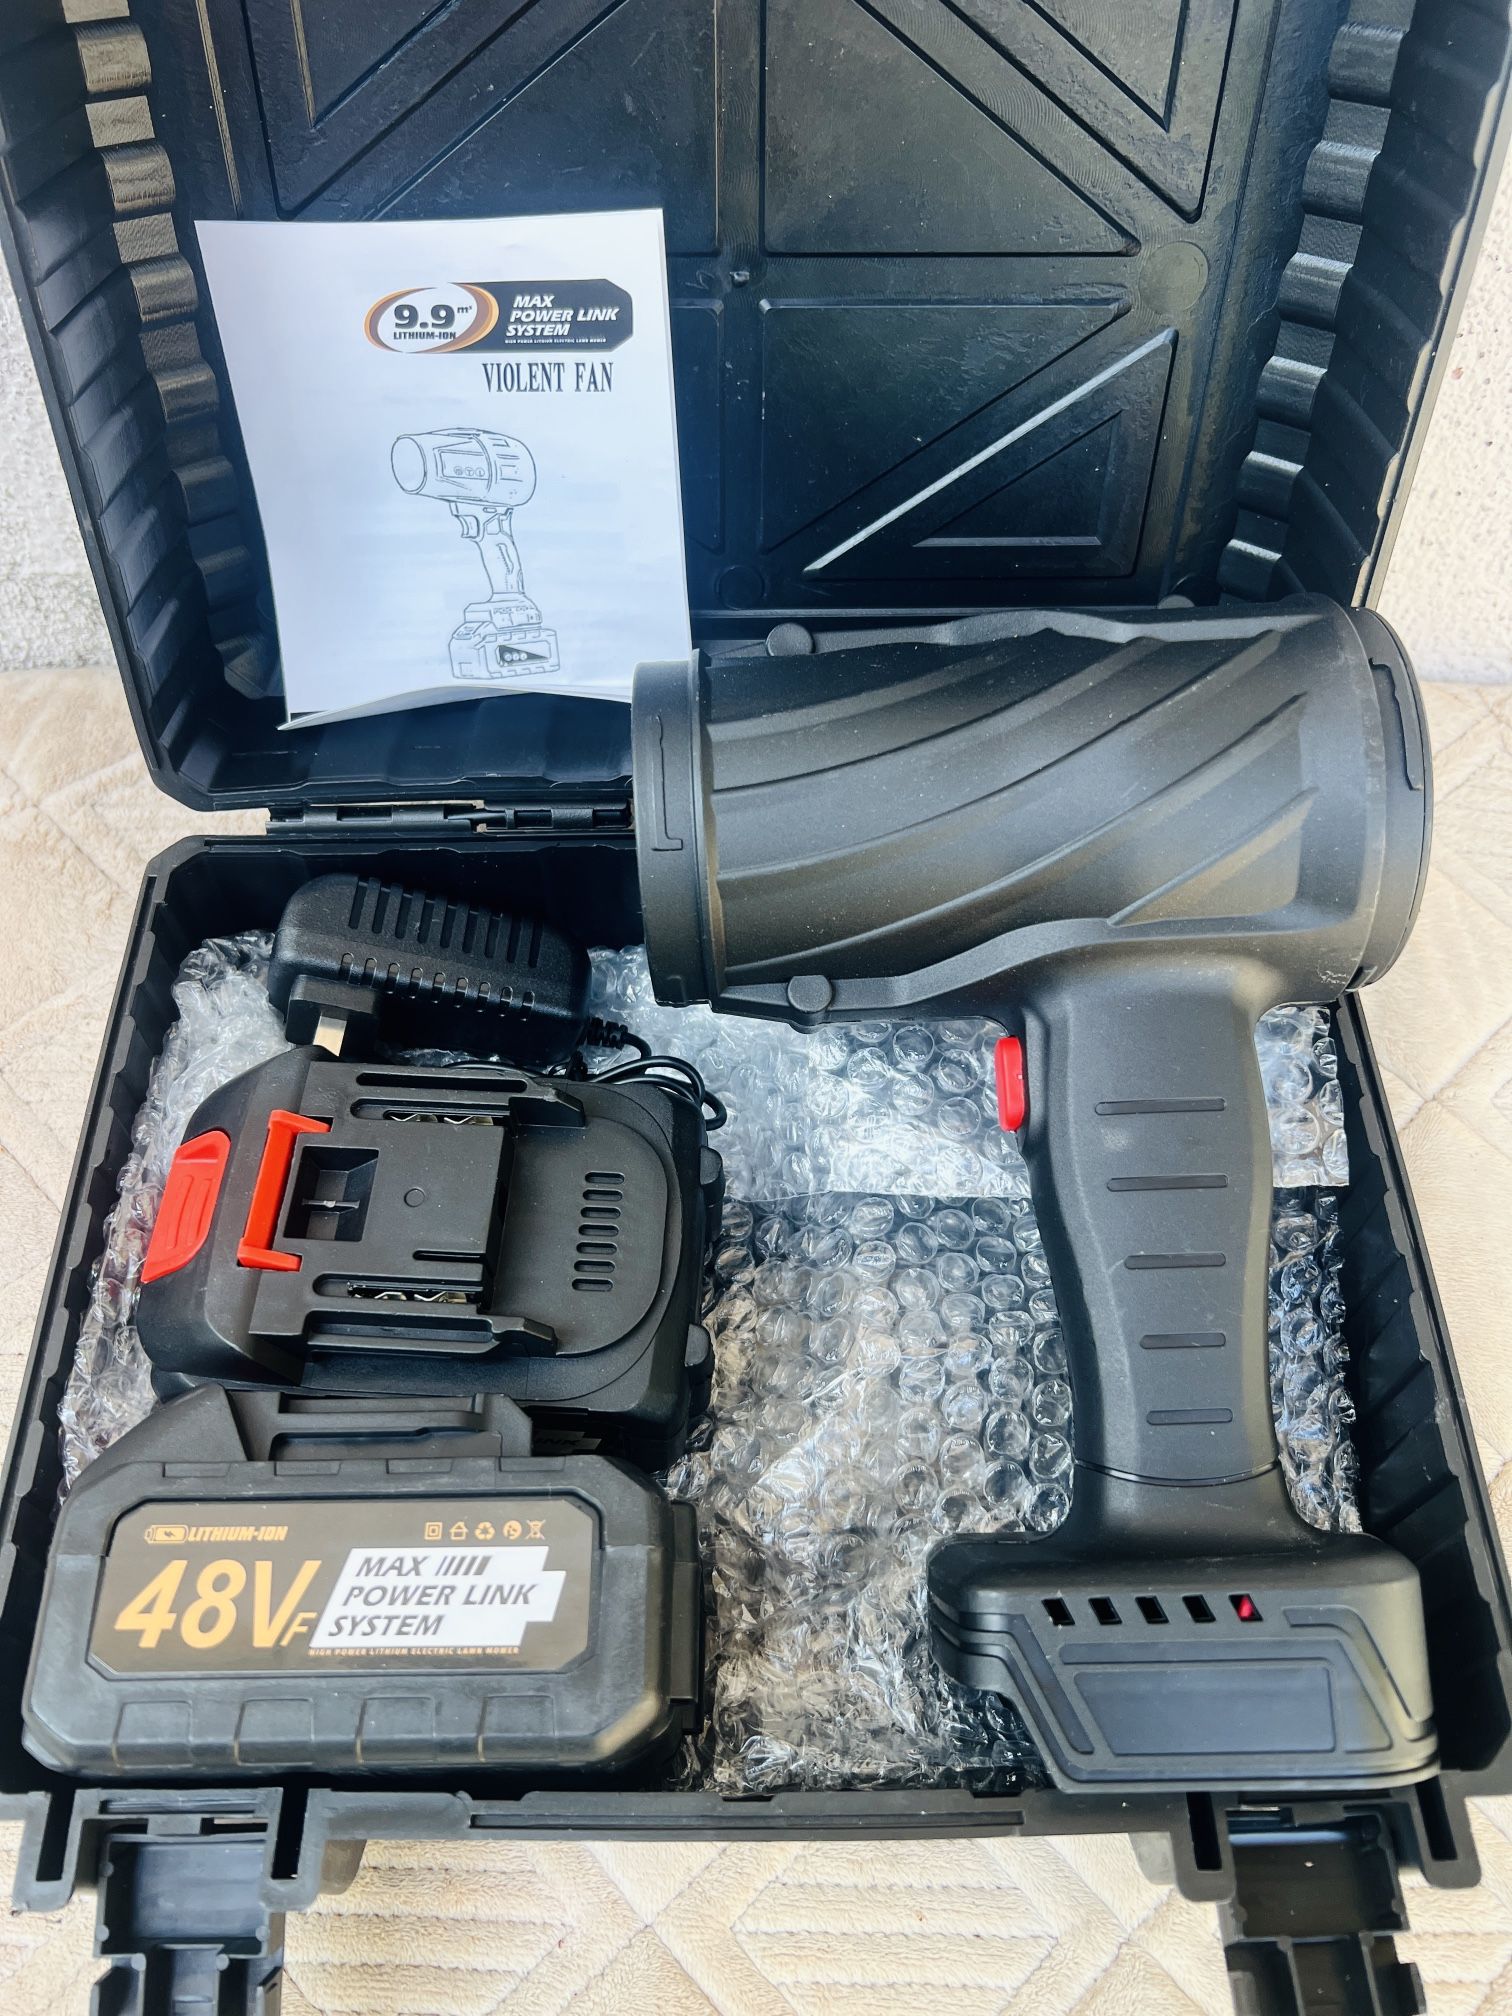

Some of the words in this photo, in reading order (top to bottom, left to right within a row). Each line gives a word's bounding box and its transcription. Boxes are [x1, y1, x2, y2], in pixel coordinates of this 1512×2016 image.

[513, 295, 555, 308] MAX
[394, 304, 456, 330] 9.9
[510, 309, 575, 323] POWER
[577, 308, 620, 322] LINK
[393, 331, 457, 341] LITHIUM-ION
[506, 323, 571, 337] SYSTEM
[482, 362, 566, 393] VIOLENT
[574, 361, 615, 393] FAN
[187, 1525, 289, 1542] LITHIUM-ION
[355, 1555, 429, 1577] MAX
[342, 1584, 456, 1607] POWER
[462, 1583, 539, 1606] LINK
[327, 1613, 446, 1637] SYSTEM
[333, 1647, 367, 1656] POWER
[368, 1647, 409, 1656] LITHIUM
[410, 1646, 454, 1656] ELECTRIC
